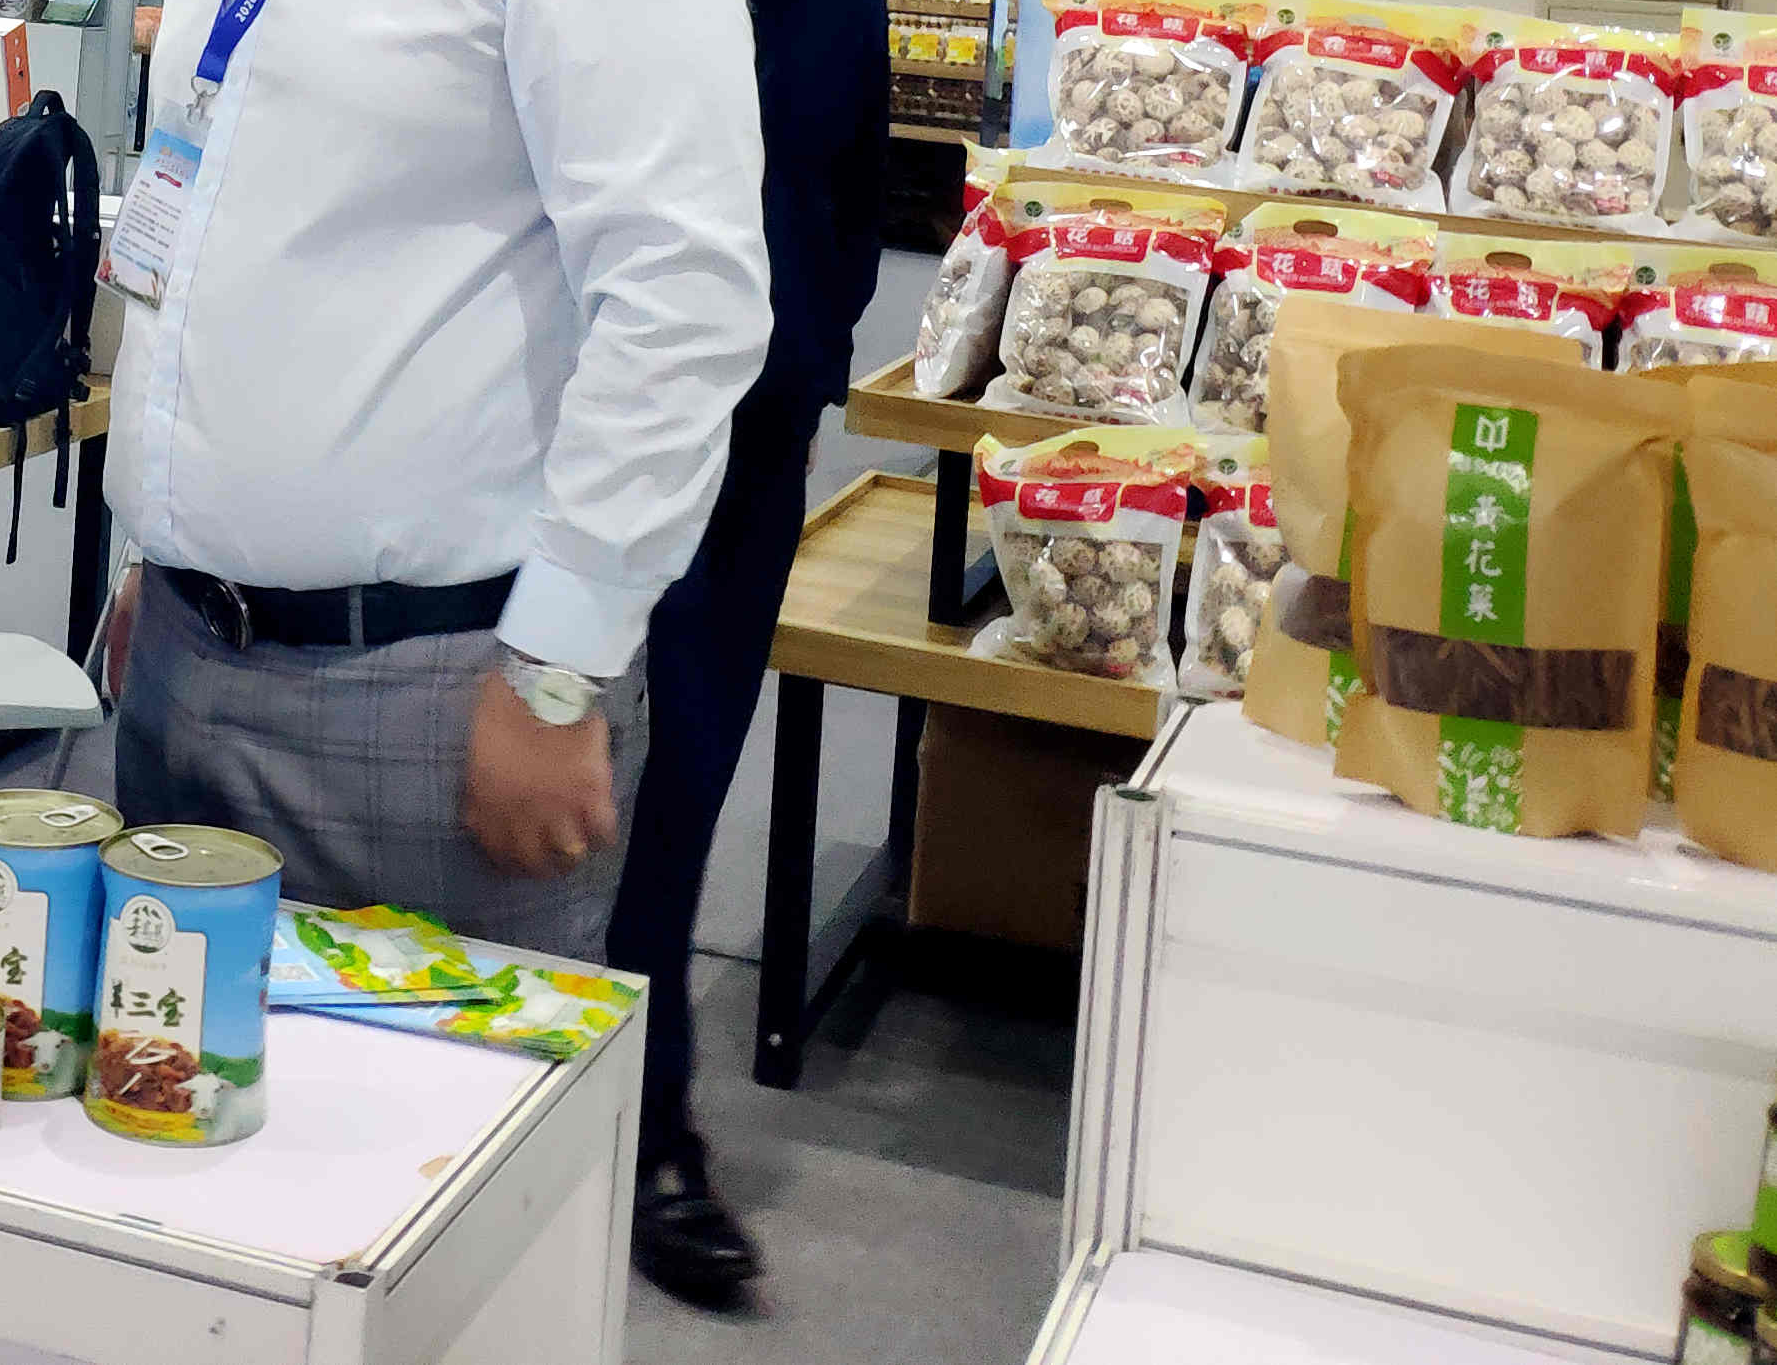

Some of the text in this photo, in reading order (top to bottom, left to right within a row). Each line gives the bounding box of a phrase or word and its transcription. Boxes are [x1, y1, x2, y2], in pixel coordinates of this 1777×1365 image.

[1066, 223, 1136, 246] 花菇
[1271, 252, 1343, 276] 花菇
[1464, 495, 1504, 623] 黄花菜
[110, 979, 186, 1027] 羊三宝
